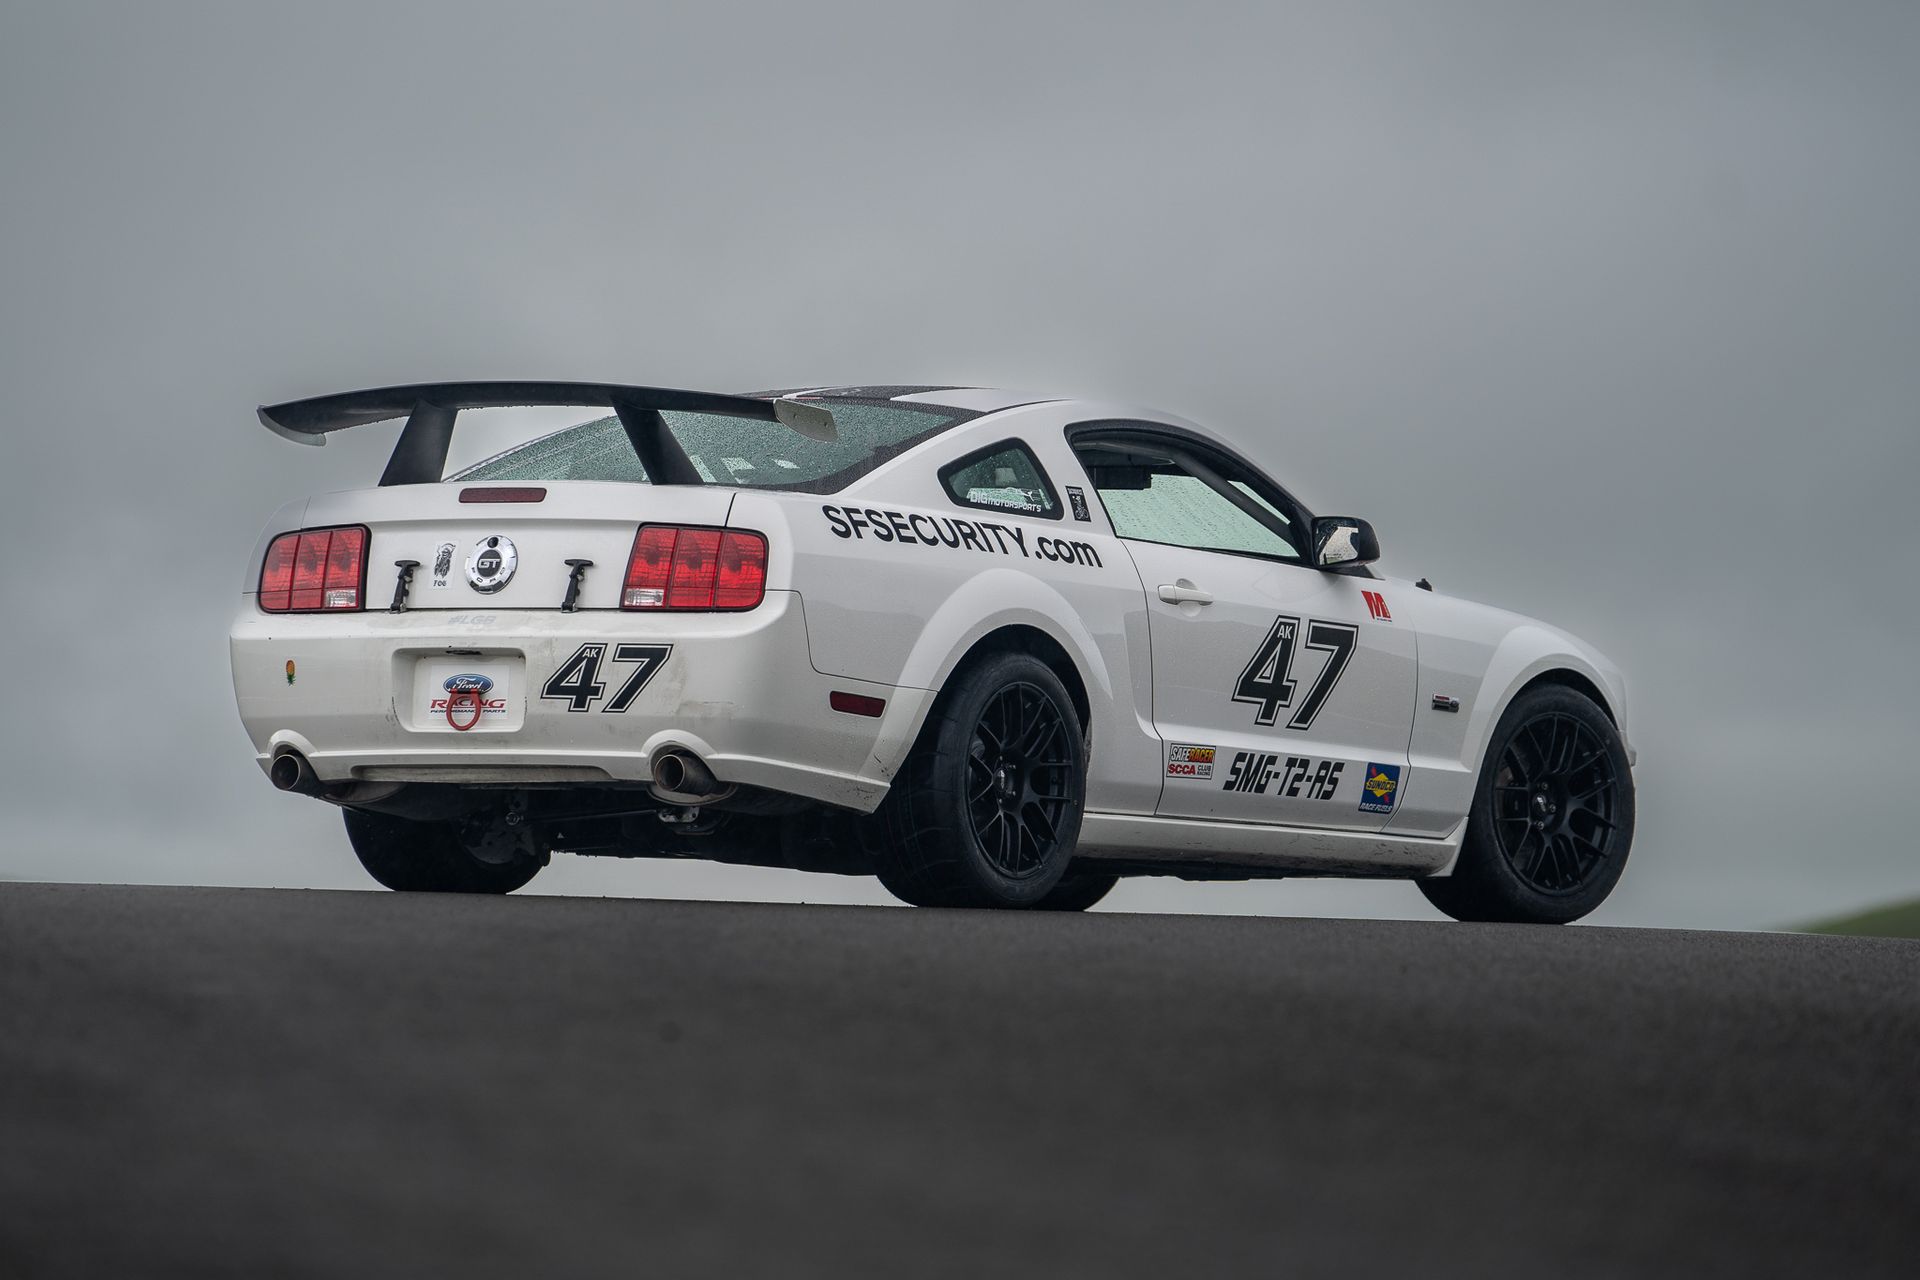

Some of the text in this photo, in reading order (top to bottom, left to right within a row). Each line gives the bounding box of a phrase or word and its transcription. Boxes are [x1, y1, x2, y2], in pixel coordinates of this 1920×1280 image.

[821, 504, 1104, 568] SFSECURITY.com
[478, 558, 501, 569] GT
[1277, 624, 1293, 640] AK
[582, 648, 599, 658] AK
[540, 642, 674, 713] 47
[1231, 614, 1360, 731] 47
[1167, 763, 1196, 776] SCCA
[1222, 751, 1346, 801] SMG-T2-AS
[1366, 779, 1395, 792] SUNOCO
[1360, 802, 1377, 811] RACE
